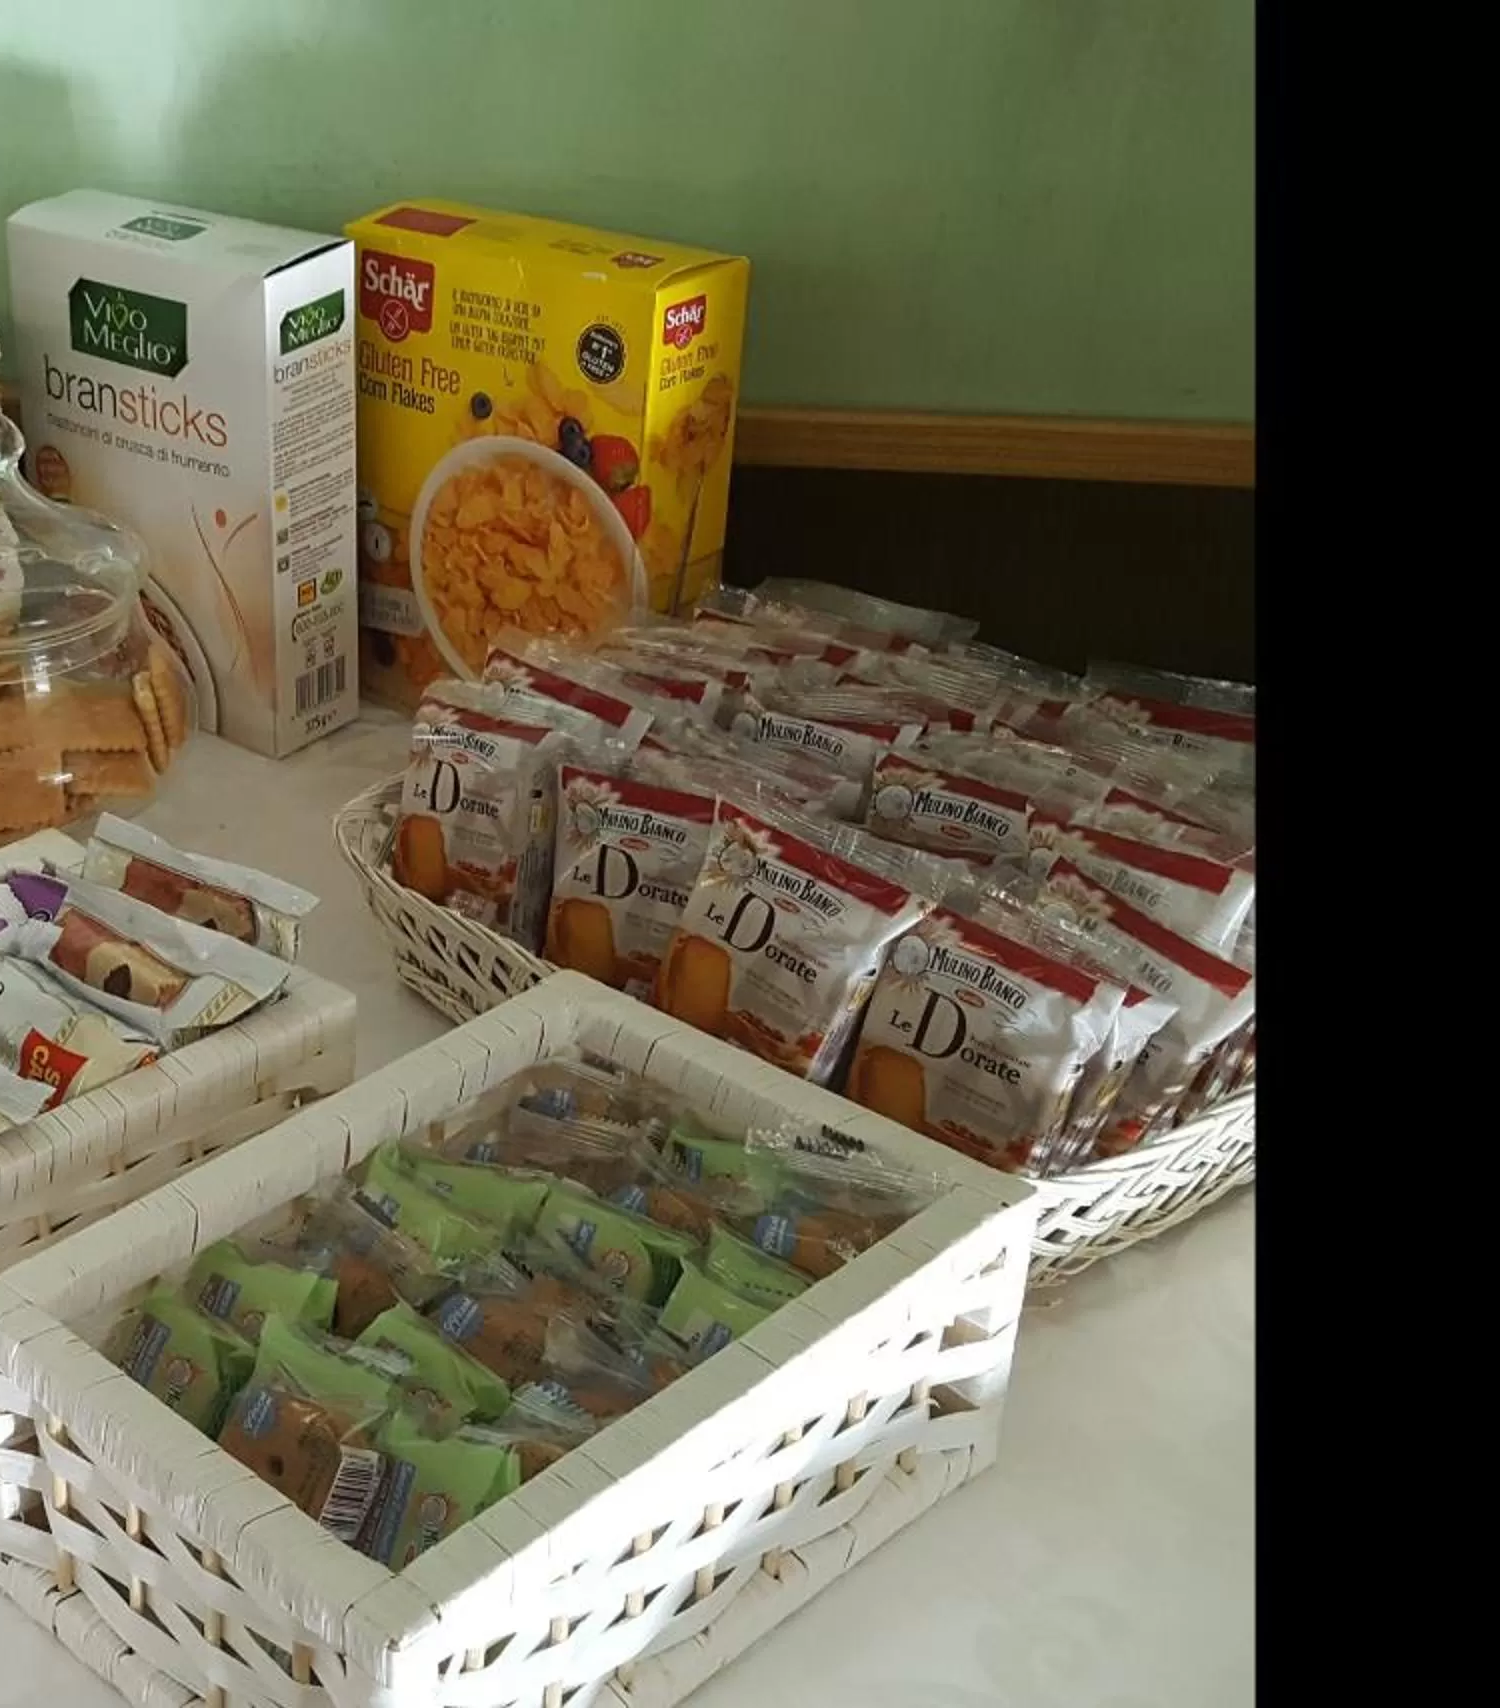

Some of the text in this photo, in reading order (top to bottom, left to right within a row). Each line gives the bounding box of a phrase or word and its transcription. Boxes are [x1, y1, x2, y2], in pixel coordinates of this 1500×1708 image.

[364, 258, 430, 312] Schär
[84, 317, 177, 365] MEGLIO
[666, 304, 704, 330] Schär
[359, 338, 461, 395] Gluten Free
[359, 371, 435, 415] Corn Flakes
[44, 353, 228, 447] bransticks
[761, 716, 843, 756] MULINO BIANCO
[414, 758, 499, 818] Le Dorate
[913, 791, 1009, 837] MULINO BIANCO
[600, 807, 686, 843] MULINO BIANCO
[573, 843, 688, 909] Le Dorate
[757, 859, 841, 919] MULINO BIANCO
[704, 890, 817, 983] Le Dorate
[930, 946, 1028, 1009] MULINO BIANCO
[889, 987, 1021, 1085] Le Dorate
